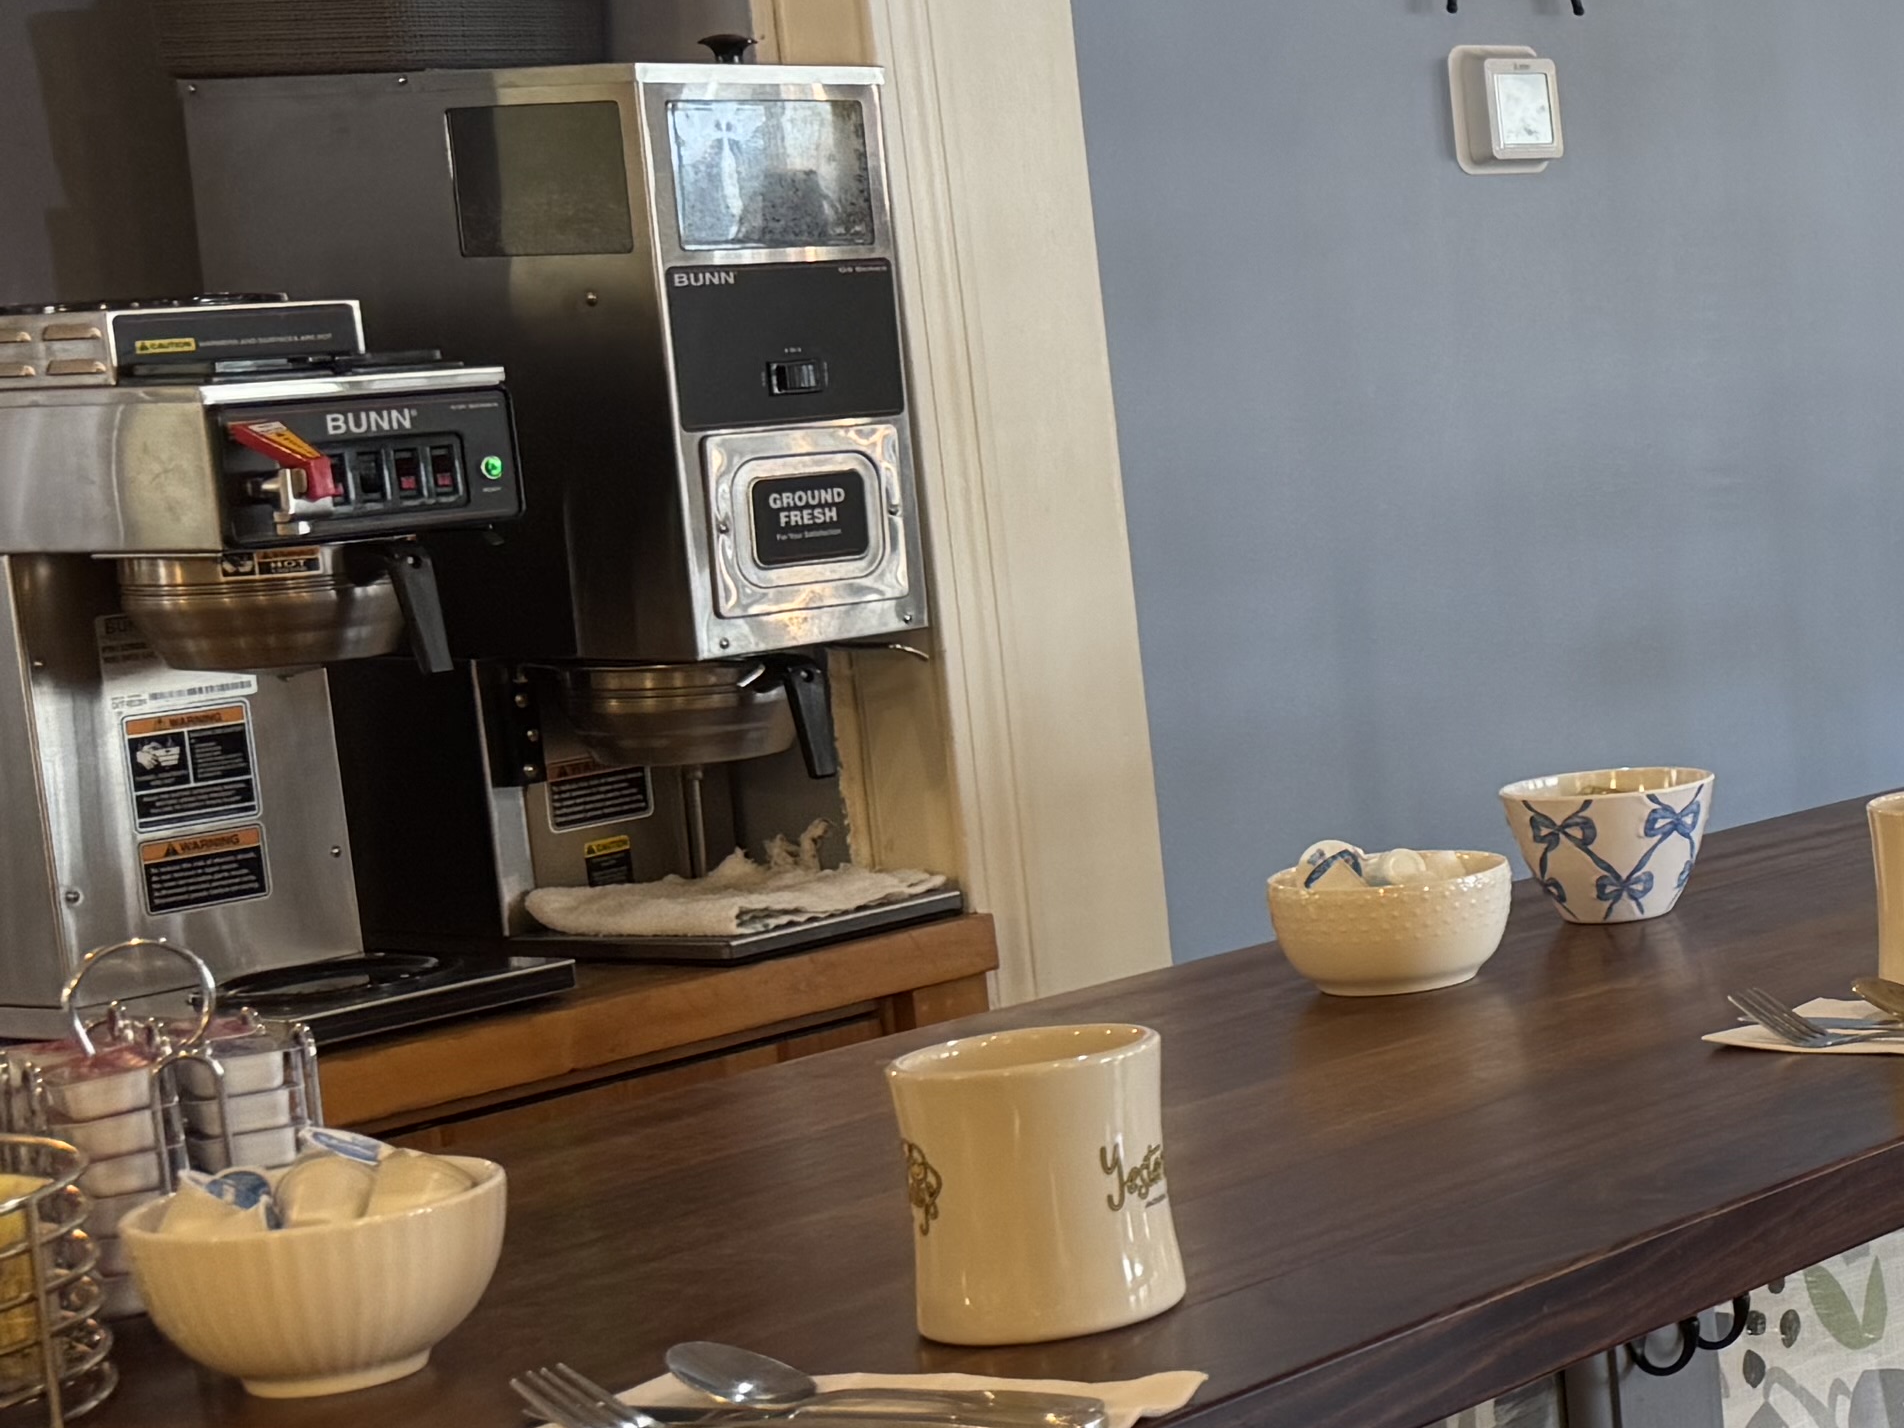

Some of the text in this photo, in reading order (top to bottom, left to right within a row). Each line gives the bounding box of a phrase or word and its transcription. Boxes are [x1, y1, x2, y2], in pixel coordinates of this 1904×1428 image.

[674, 272, 735, 287] BUNN
[768, 487, 846, 509] GROUND
[779, 506, 838, 527] FRESH
[169, 712, 223, 727] WARNING
[179, 834, 240, 852] WARNING
